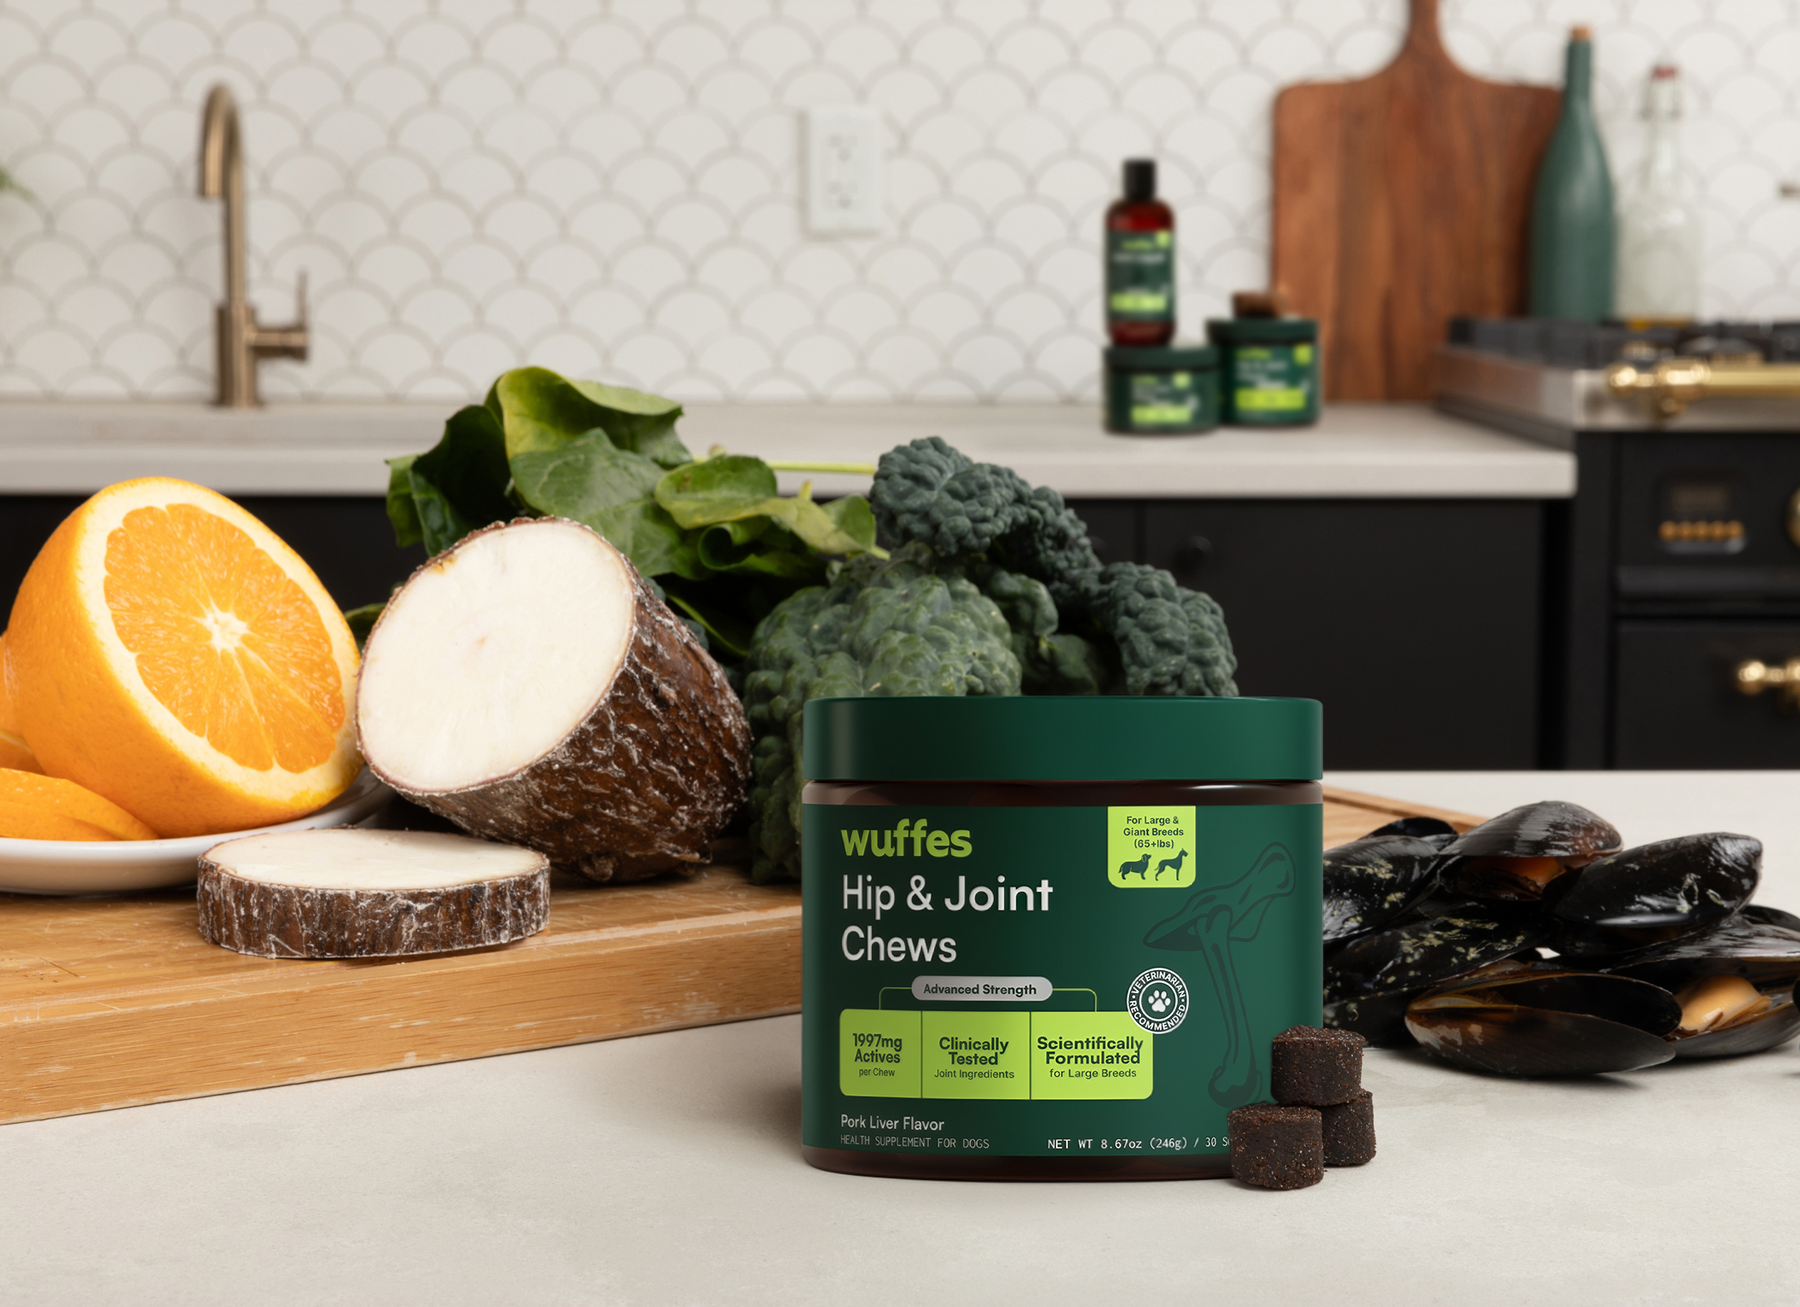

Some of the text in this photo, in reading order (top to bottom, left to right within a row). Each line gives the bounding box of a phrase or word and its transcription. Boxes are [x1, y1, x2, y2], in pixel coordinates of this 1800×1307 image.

[1126, 816, 1179, 826] For Large &
[841, 818, 973, 858] wuffes
[1123, 827, 1184, 836] Giant Breeds
[1133, 839, 1174, 849] (65+lbs)
[843, 874, 1054, 921] Hip & Joint
[841, 925, 957, 963] Chews
[923, 983, 1037, 998] Advanced Strength
[1131, 971, 1186, 998] VETERINARIAN
[1130, 1000, 1186, 1031] RECOMMENDED
[852, 1033, 903, 1052] 1997mg
[939, 1036, 1009, 1055] Clinically
[1037, 1036, 1144, 1052] Scientifically
[854, 1049, 901, 1064] Actives
[948, 1052, 999, 1066] Tested
[1046, 1051, 1141, 1065] Formulated
[858, 1067, 896, 1078] per Chew
[934, 1069, 1015, 1080] Joint Ingredients
[1049, 1068, 1137, 1080] for Large Breeds
[840, 1114, 945, 1131] Pork Liver Flavor
[840, 1134, 990, 1149] HEALTH SUPPLEMENT FOR DOGS
[1047, 1138, 1071, 1149] NET
[1078, 1138, 1093, 1149] WT
[1100, 1138, 1143, 1149] 8.67oz
[1149, 1136, 1188, 1151] (246g)
[1193, 1137, 1200, 1148] /
[1205, 1136, 1217, 1148] 30
